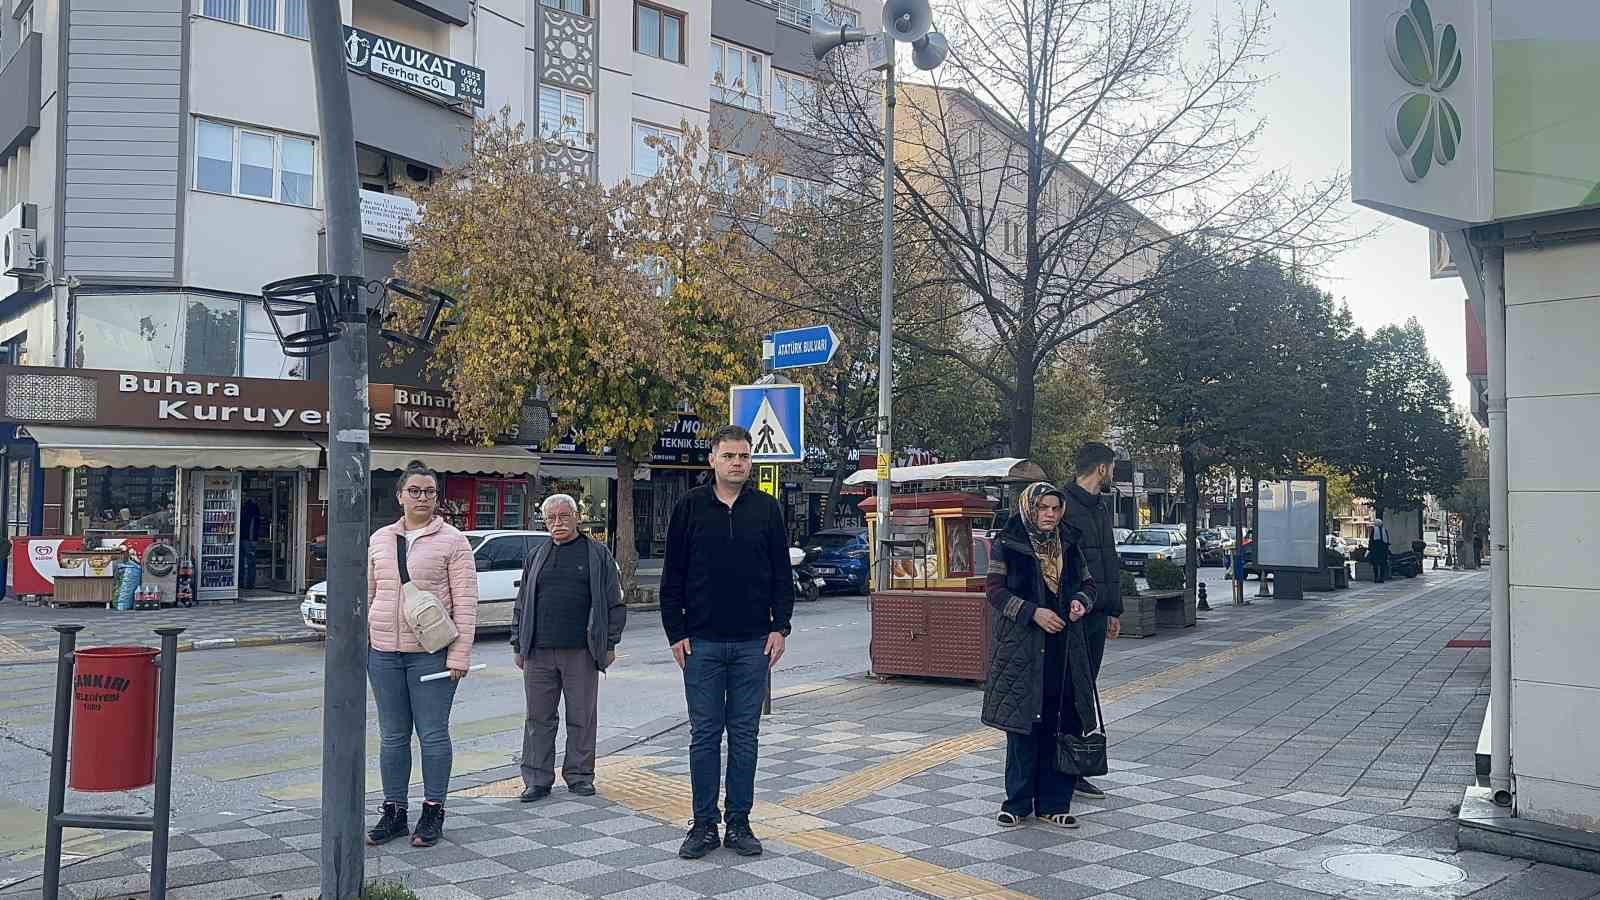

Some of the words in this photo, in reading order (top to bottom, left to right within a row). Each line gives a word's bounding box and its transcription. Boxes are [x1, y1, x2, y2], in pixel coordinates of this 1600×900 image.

[372, 39, 456, 78] AVUKAT
[381, 62, 419, 82] Ferhat
[119, 374, 240, 397] Buhara
[394, 389, 455, 409] Buhar
[158, 400, 393, 431] Kuruyeş
